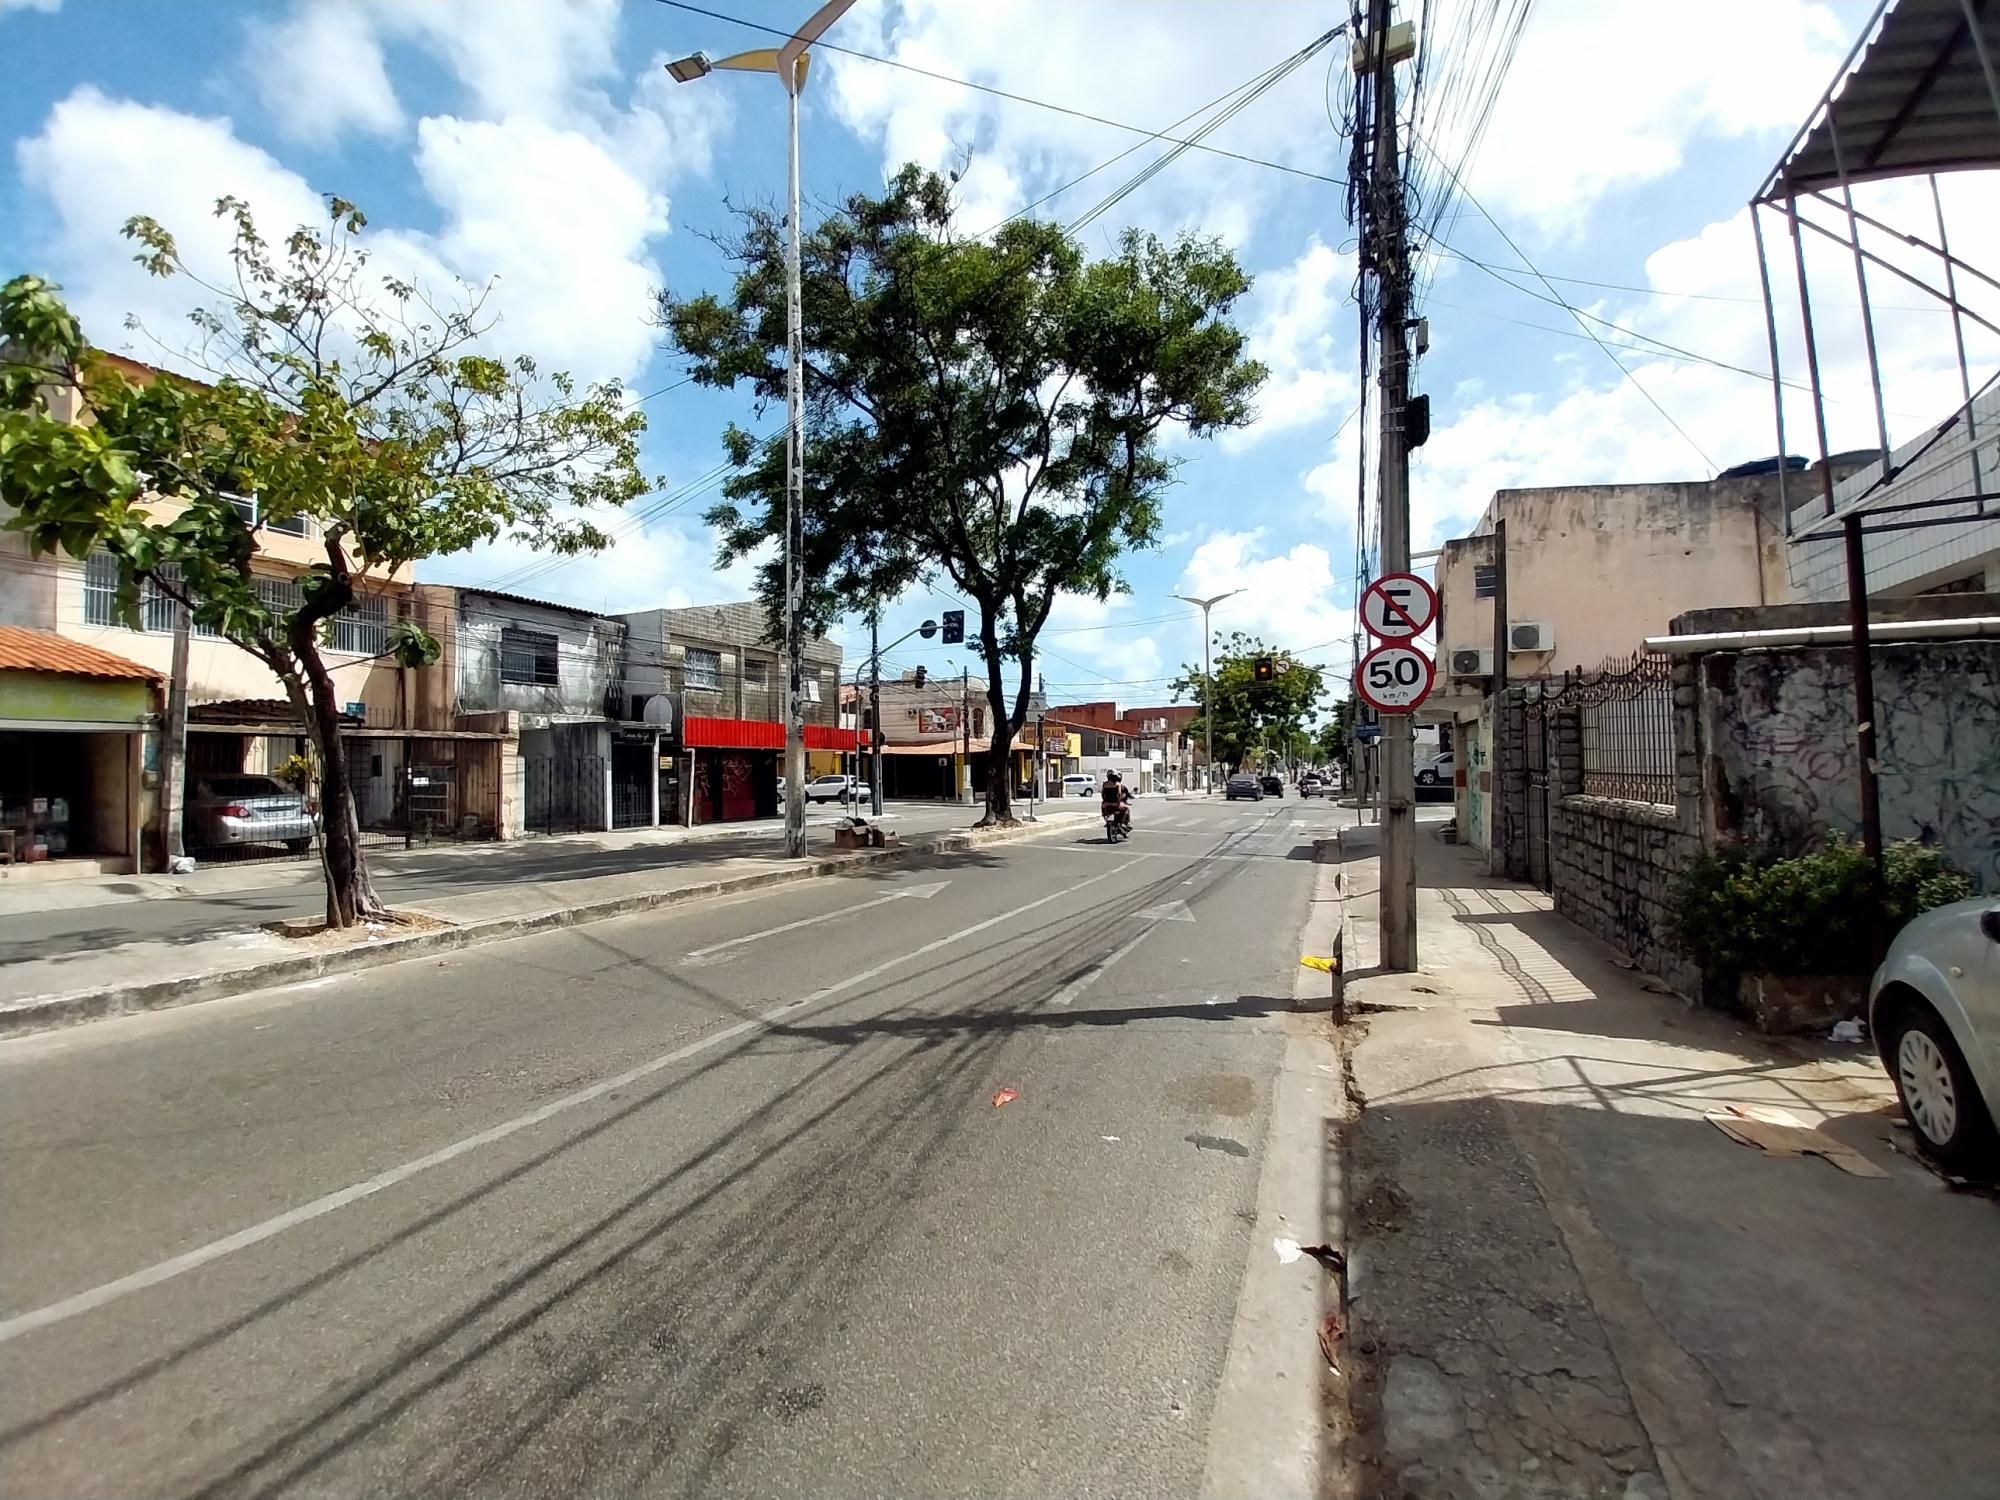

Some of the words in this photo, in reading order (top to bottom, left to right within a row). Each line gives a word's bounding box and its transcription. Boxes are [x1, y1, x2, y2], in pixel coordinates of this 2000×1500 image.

[1382, 589, 1411, 626] E
[1369, 657, 1420, 689] 50
[1382, 691, 1409, 700] km/h
